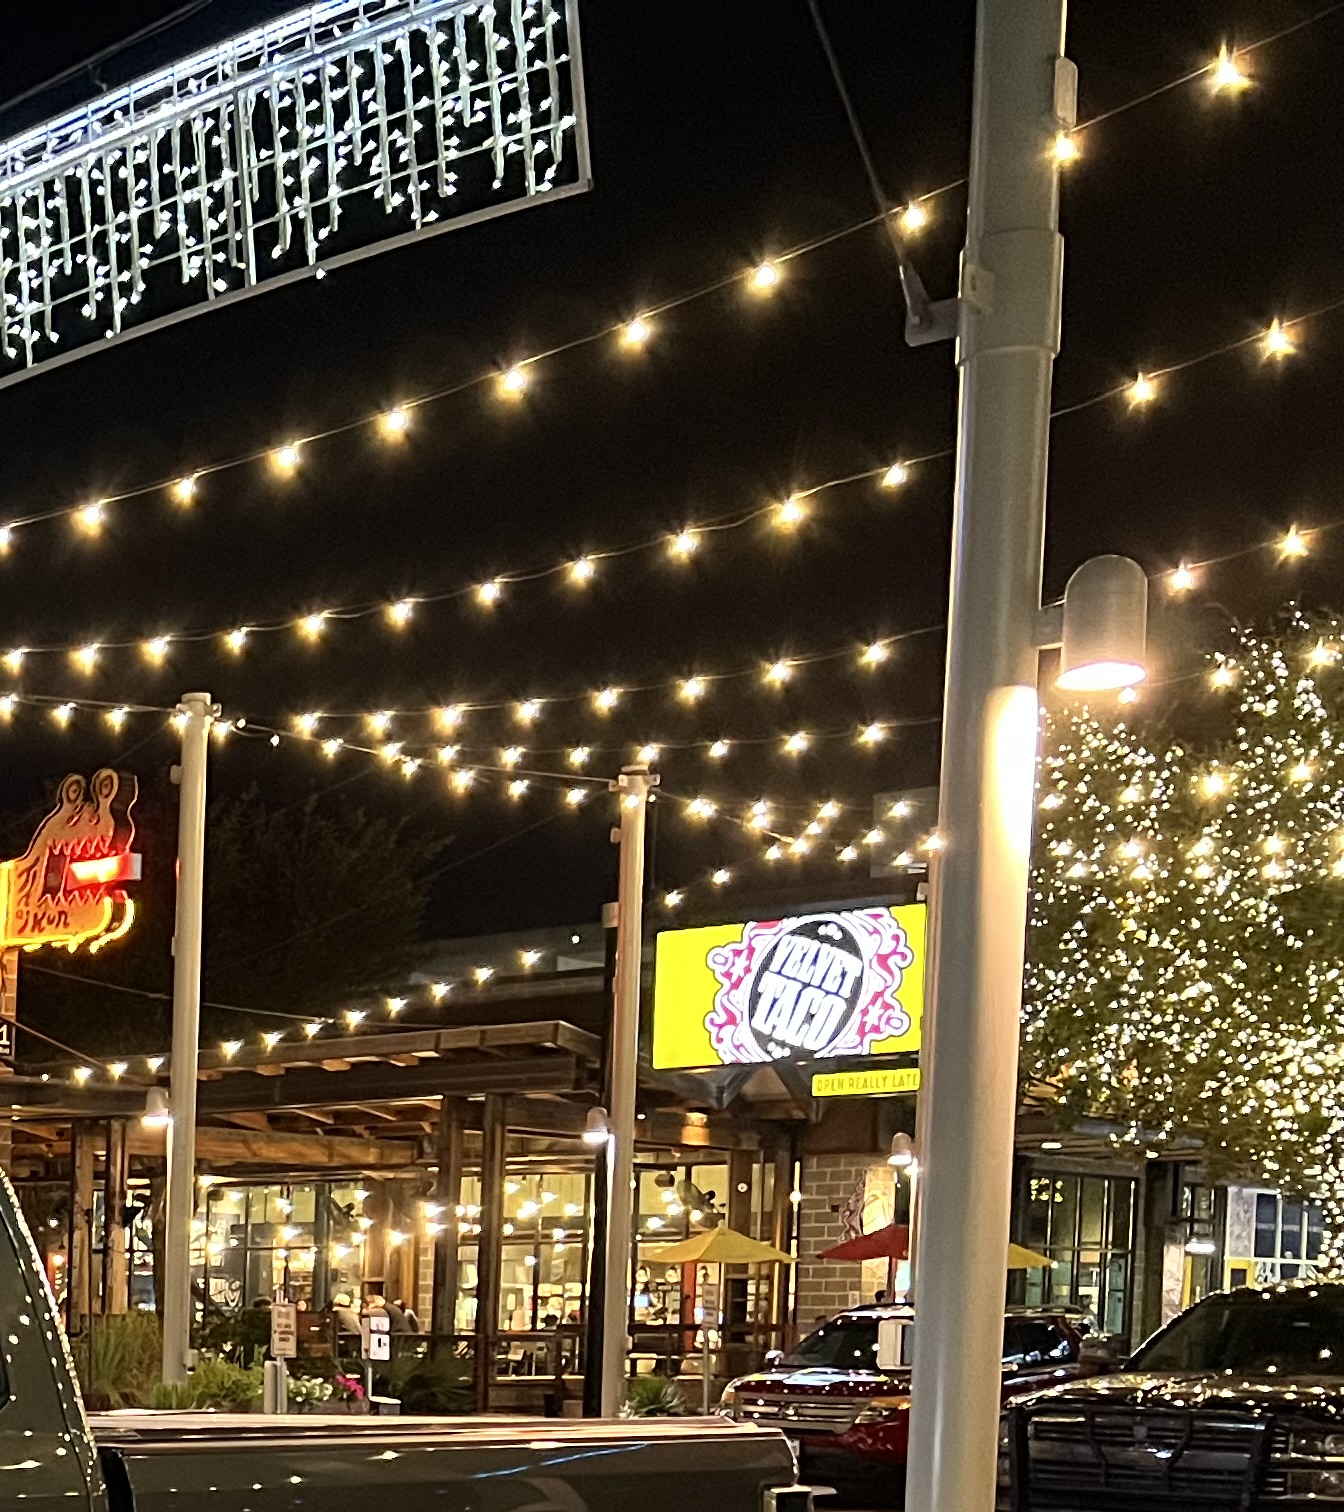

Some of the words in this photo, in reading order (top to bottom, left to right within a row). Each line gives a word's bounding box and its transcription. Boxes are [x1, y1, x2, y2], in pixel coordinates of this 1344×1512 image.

[767, 934, 863, 998] VELVET
[751, 972, 848, 1052] TACO
[816, 1078, 844, 1092] OPEN
[848, 1076, 888, 1090] REALLY
[892, 1073, 918, 1088] LATE
